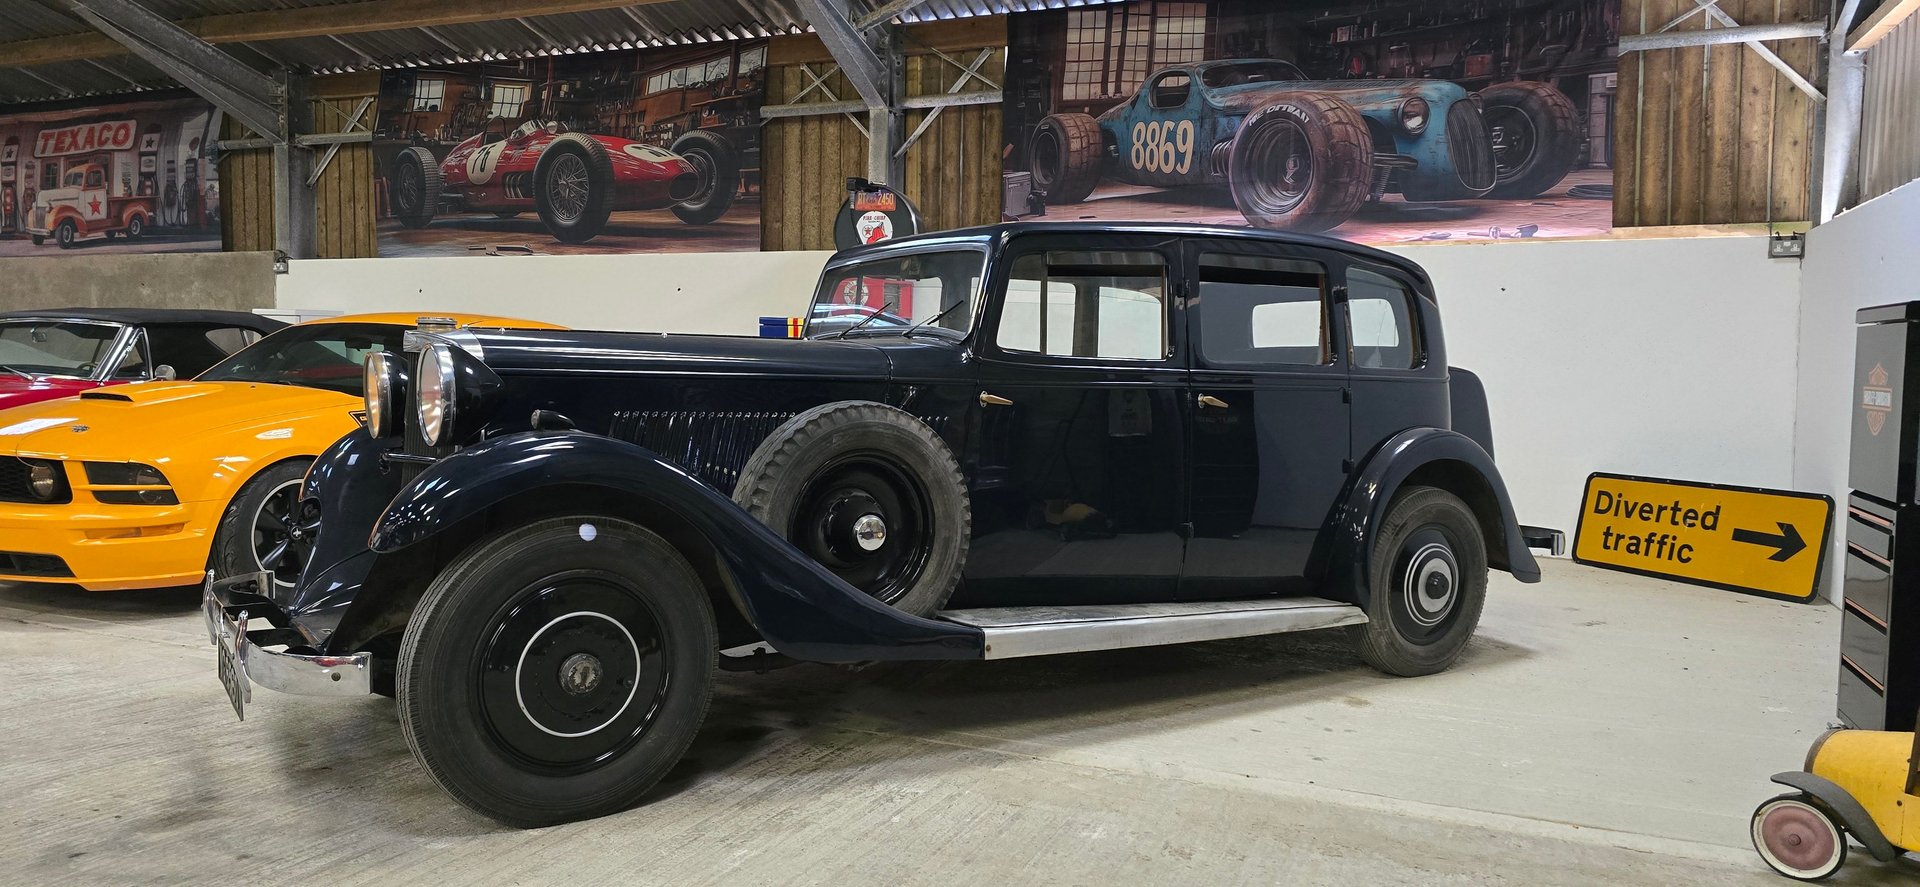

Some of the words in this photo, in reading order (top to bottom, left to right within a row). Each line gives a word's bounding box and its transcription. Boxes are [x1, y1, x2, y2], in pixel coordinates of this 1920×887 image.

[41, 123, 130, 154] TEXACO
[1131, 120, 1194, 175] 8869
[878, 193, 894, 205] 2450
[1593, 490, 1722, 531] Diverted
[1602, 525, 1694, 564] traffic
